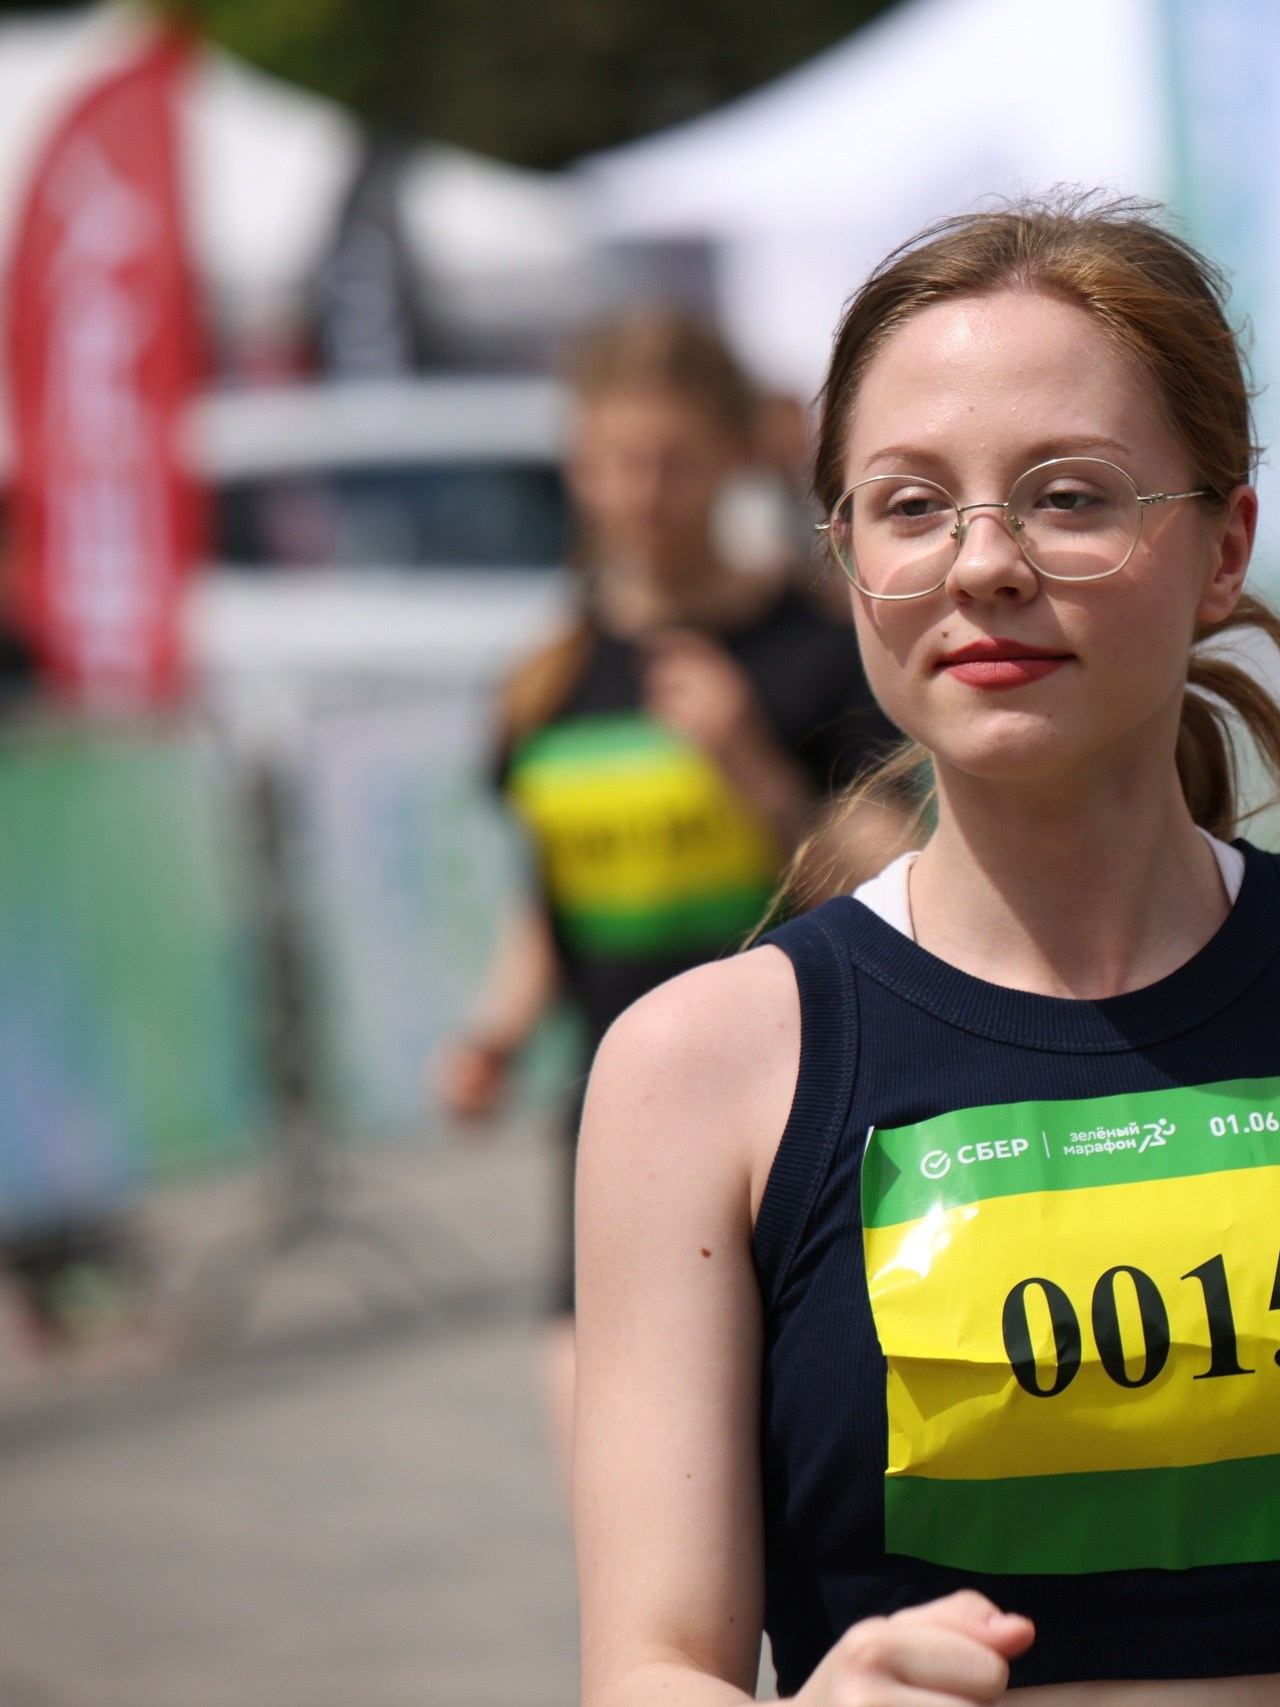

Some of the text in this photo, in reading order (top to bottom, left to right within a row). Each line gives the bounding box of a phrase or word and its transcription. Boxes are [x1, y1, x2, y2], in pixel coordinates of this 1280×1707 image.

[1069, 1121, 1140, 1143] зелёный
[957, 1138, 1029, 1164] СБЕР
[1063, 1137, 1137, 1156] марафон
